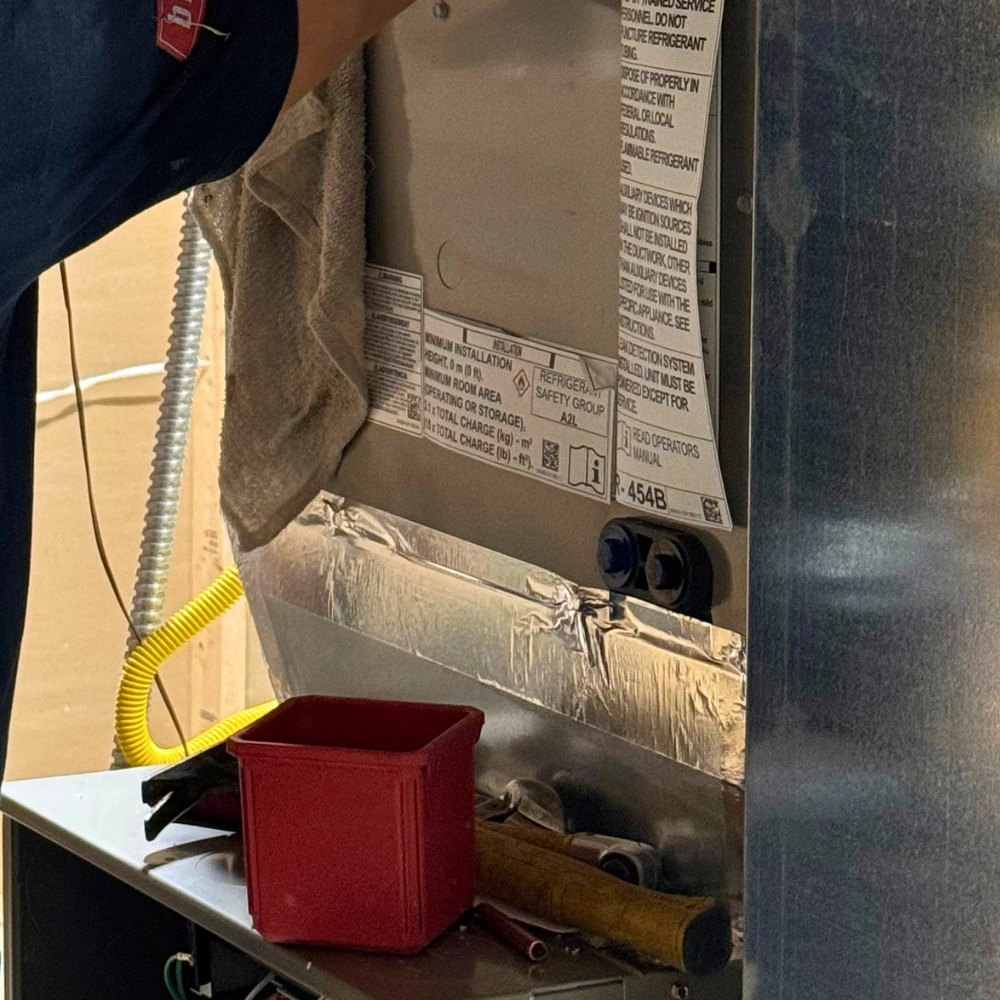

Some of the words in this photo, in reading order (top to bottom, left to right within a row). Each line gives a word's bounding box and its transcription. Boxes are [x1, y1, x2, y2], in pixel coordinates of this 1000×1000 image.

[656, 12, 668, 26] DO
[668, 13, 688, 29] NOT
[648, 30, 706, 52] REFRIGERANT
[640, 70, 650, 84] OF
[650, 72, 690, 92] PROPERLY
[690, 78, 700, 94] IN
[657, 92, 675, 109] WITH
[642, 108, 650, 122] OR
[651, 111, 674, 128] LOCAL
[650, 148, 699, 172] REFRIGERANT
[644, 190, 668, 210] DEVICES
[669, 197, 692, 216] WHICH
[660, 214, 692, 236] SOURCES
[634, 225, 644, 240] NOT
[645, 228, 654, 244] BE
[654, 232, 688, 254] INSTALLED
[668, 255, 690, 276] OTHER
[658, 272, 687, 293] DEVICES
[634, 282, 646, 298] FOR
[658, 290, 675, 308] WITH
[676, 296, 690, 314] THE
[675, 315, 690, 332] SEE
[424, 332, 453, 352] MINIMUM
[454, 342, 512, 372] INSTALLATION
[663, 354, 695, 376] SYSTEM
[424, 366, 452, 386] MINIMUM
[452, 378, 476, 396] ROOM
[478, 386, 502, 404] AREA
[644, 366, 660, 384] UNIT
[660, 372, 682, 391] MUST
[683, 378, 696, 395] BE
[464, 400, 477, 414] OR
[536, 386, 571, 406] SAFETY
[572, 398, 605, 416] GROUP
[642, 384, 670, 406] EXCEPT
[671, 394, 690, 412] FOR
[436, 406, 458, 426] TOTAL
[460, 416, 496, 438] CHARGE
[496, 428, 514, 446] (kg)
[560, 412, 578, 427] A2L
[436, 422, 458, 443] TOTAL
[460, 434, 496, 456] CHARGE
[496, 446, 511, 464] (lb)
[632, 427, 650, 446] READ
[652, 434, 700, 459] OPERATORS
[632, 446, 662, 468] MANUAL
